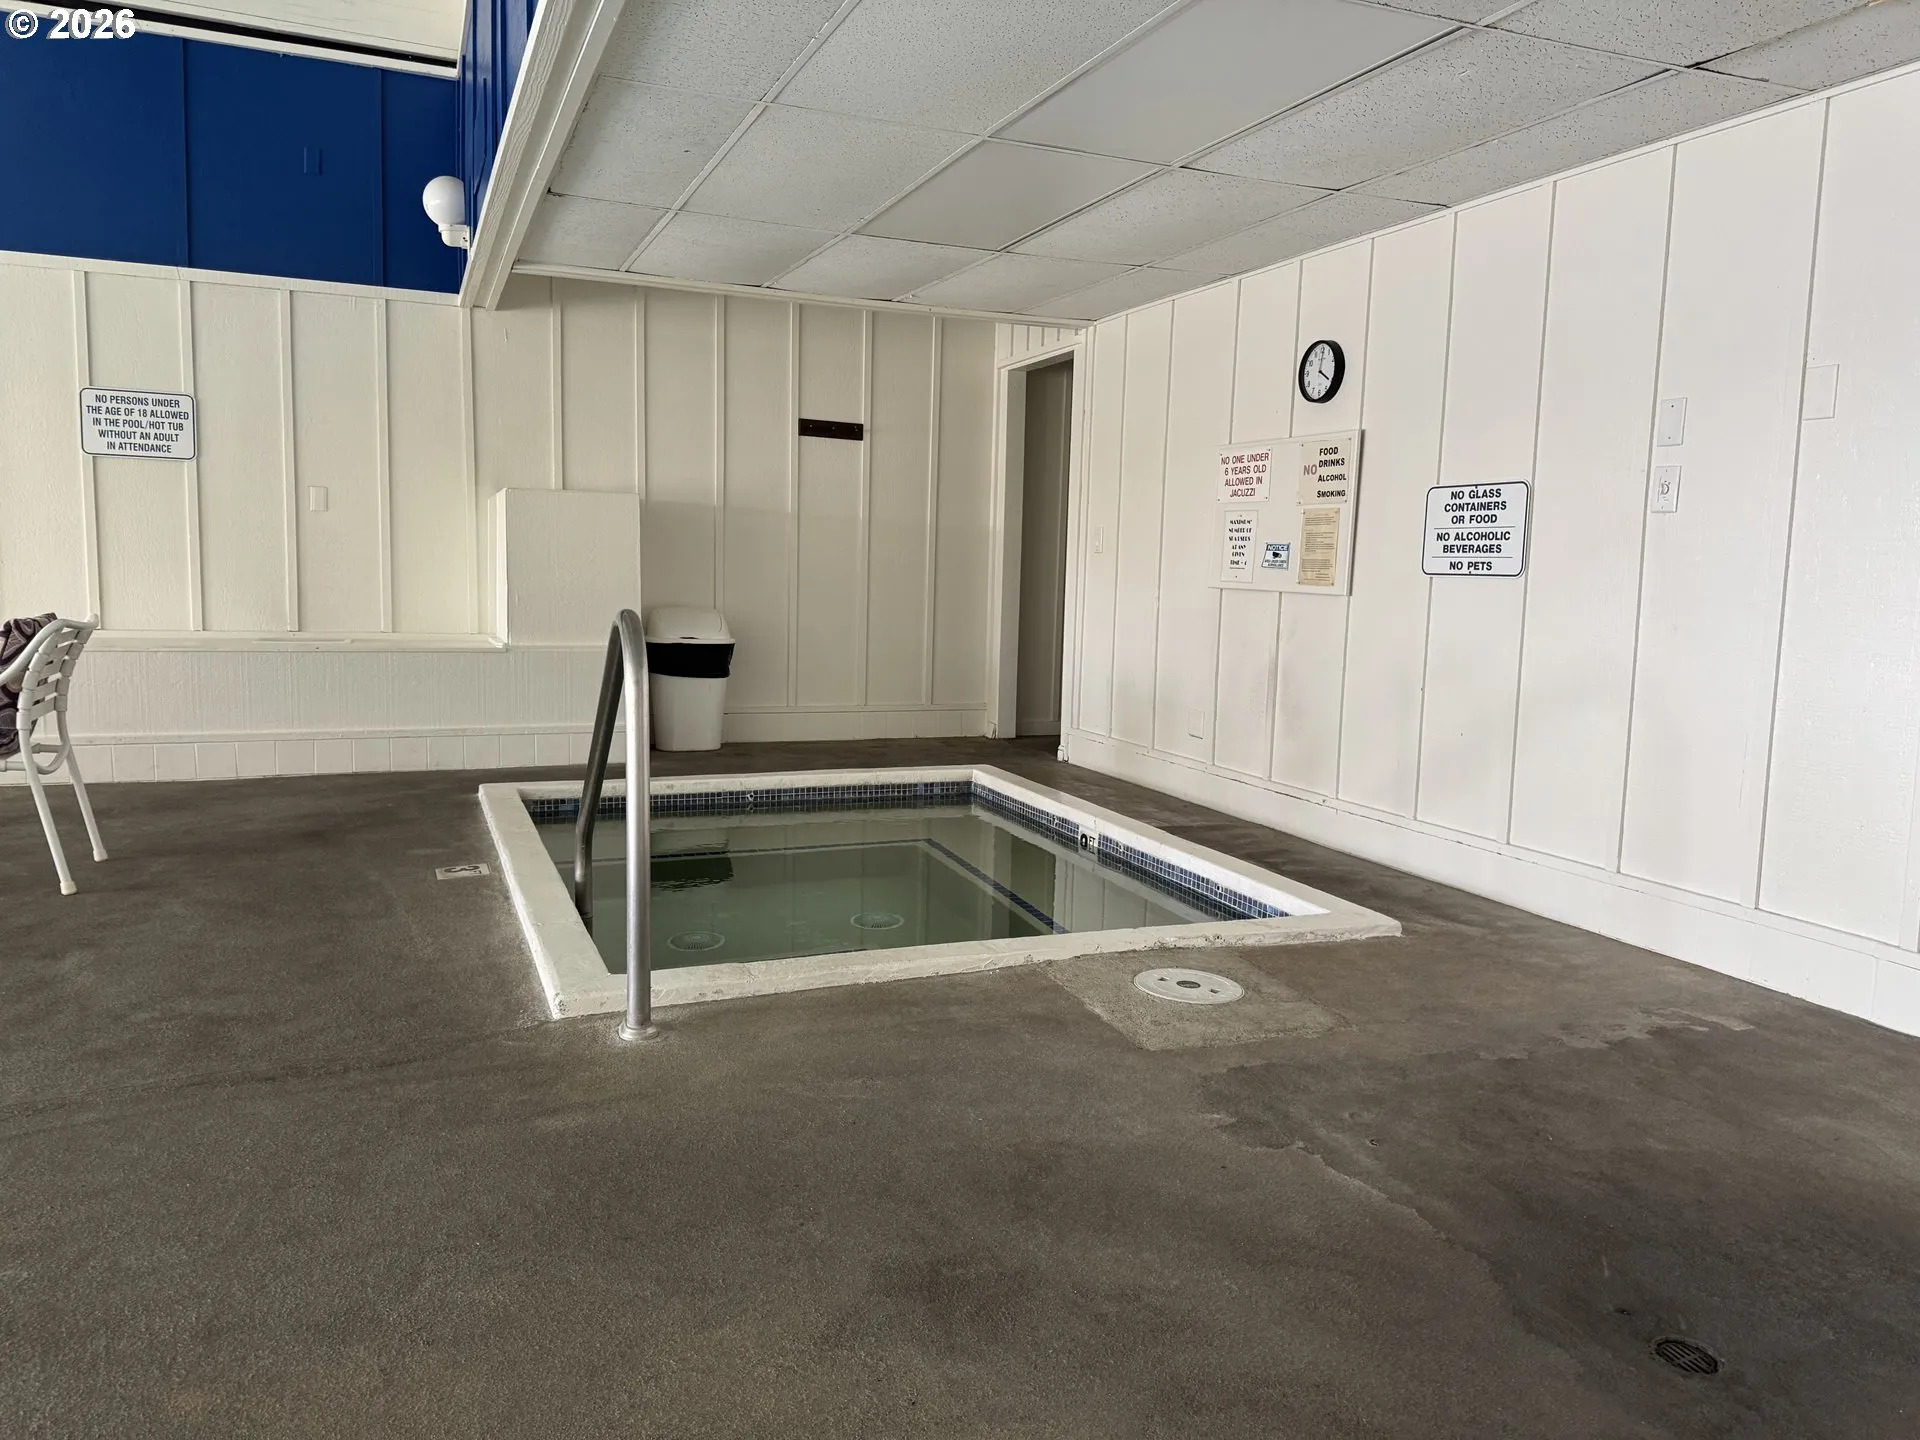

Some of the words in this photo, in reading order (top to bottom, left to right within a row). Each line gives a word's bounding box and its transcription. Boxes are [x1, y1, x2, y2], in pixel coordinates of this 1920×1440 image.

[95, 394, 107, 403] NO
[110, 396, 149, 406] PERSONS
[152, 398, 180, 408] UNDER
[86, 406, 102, 414] THE
[105, 407, 121, 416] AGE
[124, 408, 135, 417] OF
[138, 409, 147, 417] 18
[150, 410, 189, 420] ALLOWED
[92, 418, 101, 426] IN
[104, 418, 120, 427] THE
[123, 419, 165, 430] POOL/HOT
[168, 422, 184, 431] TUB
[98, 429, 137, 440] WITHOUT
[140, 432, 151, 440] AN
[153, 433, 179, 442] ADULT
[107, 442, 115, 450] IN
[118, 442, 172, 453] ATTENDANCE
[1320, 447, 1338, 456] FOOD
[1221, 456, 1230, 465] NO
[1232, 455, 1244, 464] ONE
[1246, 453, 1269, 462] UNDER
[1225, 467, 1229, 475] 6
[1231, 466, 1250, 475] YEARS
[1253, 464, 1266, 473] OLD
[1303, 464, 1317, 475] NO
[1318, 458, 1345, 468] DRINKS
[1225, 477, 1253, 486] ALLOWED
[1256, 476, 1263, 484] IN
[1318, 474, 1346, 482] ALCOHOL
[1230, 488, 1256, 497] JACUZZI
[1317, 490, 1346, 498] SMOKING
[1451, 491, 1464, 500] NO
[1469, 489, 1502, 499] GLASS
[1444, 501, 1507, 512] CONTAINERS
[1451, 515, 1464, 524] OR
[1469, 514, 1498, 524] FOOD
[1436, 533, 1450, 542] NO
[1454, 531, 1511, 541] ALCOHOLIC
[1443, 544, 1502, 554] BEVERAGES
[1449, 562, 1463, 570] NO
[1467, 561, 1492, 570] PETS
